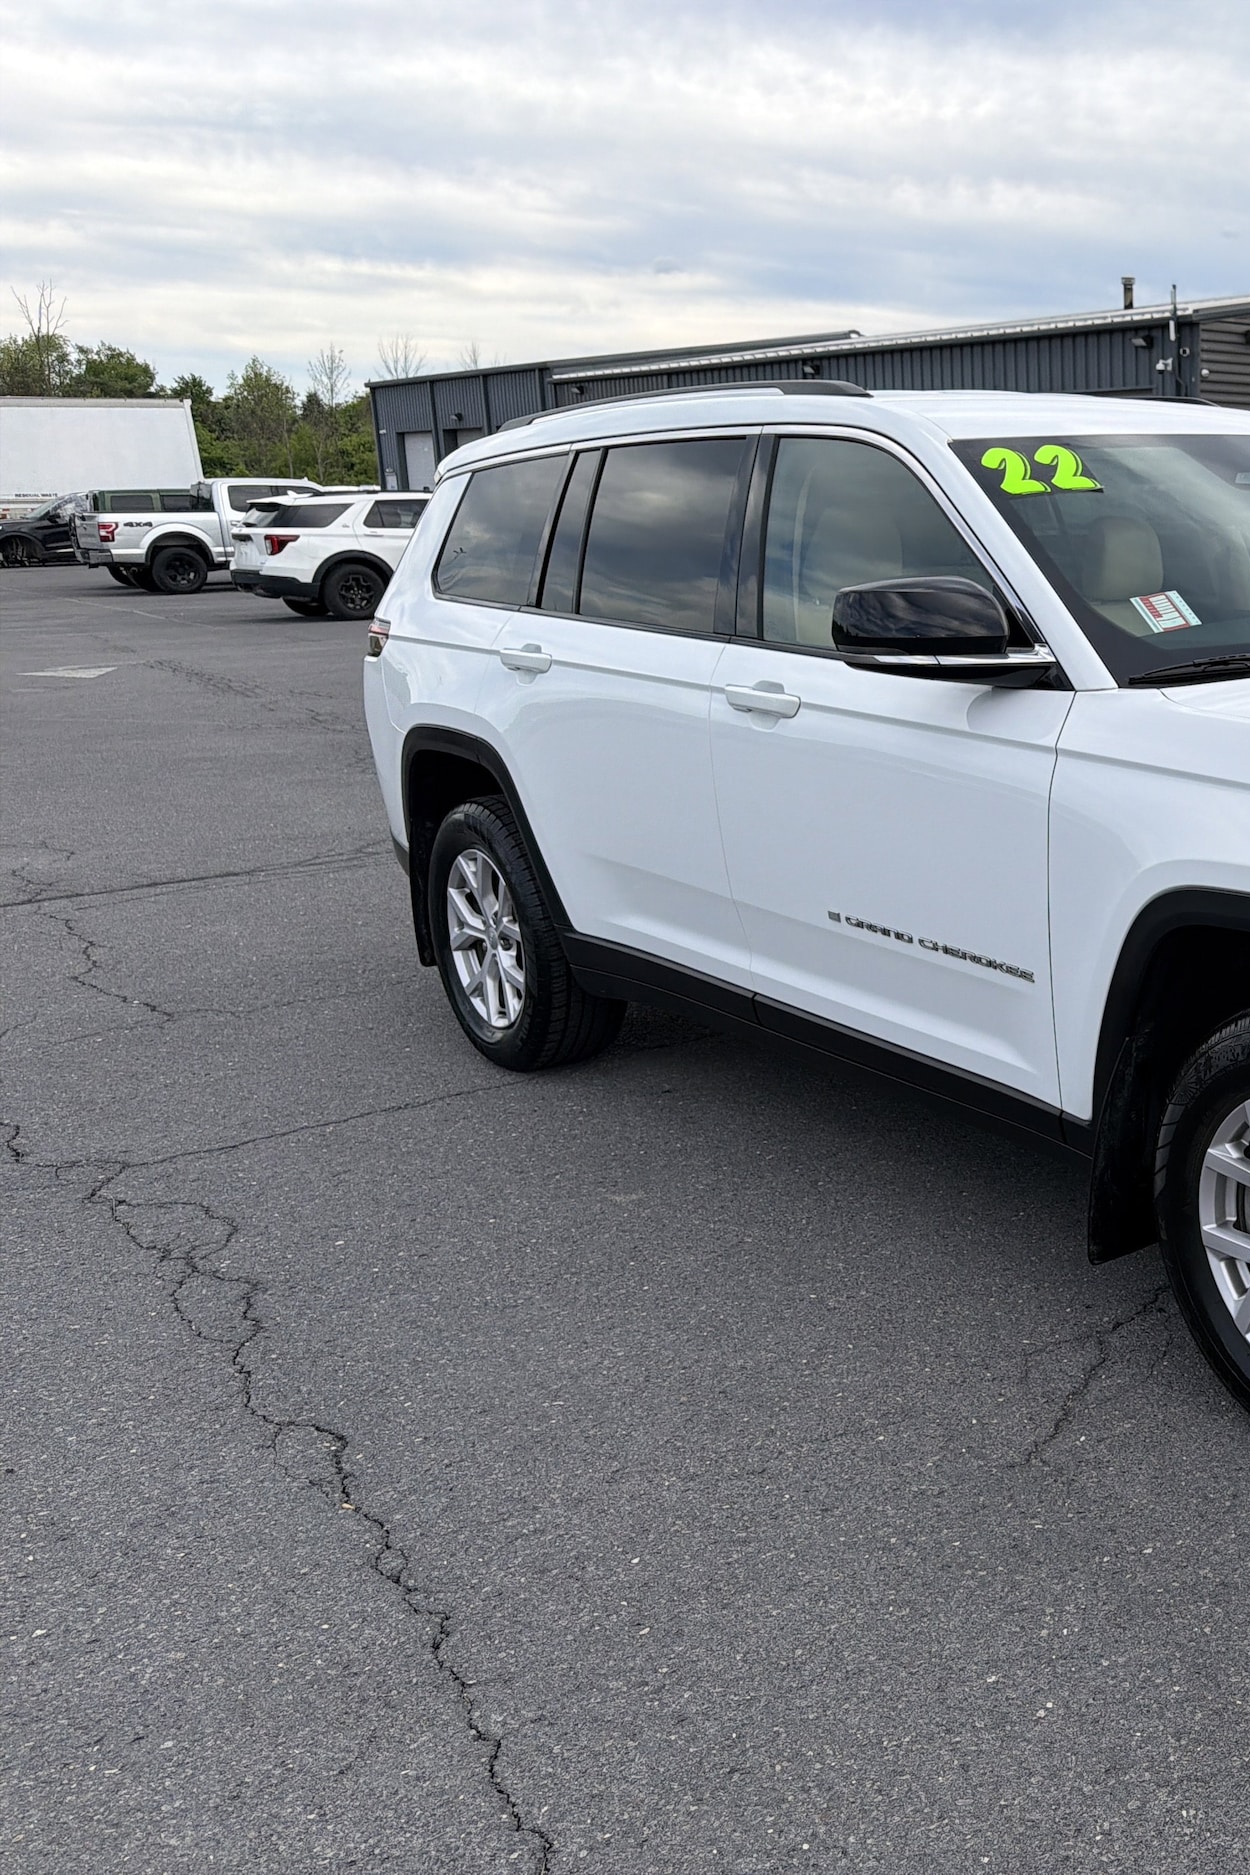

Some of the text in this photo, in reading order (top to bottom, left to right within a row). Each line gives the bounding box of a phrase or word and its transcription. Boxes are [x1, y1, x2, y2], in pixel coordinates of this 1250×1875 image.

[981, 444, 1103, 495] 22
[844, 913, 1036, 984] GRAND CHEROKEE
